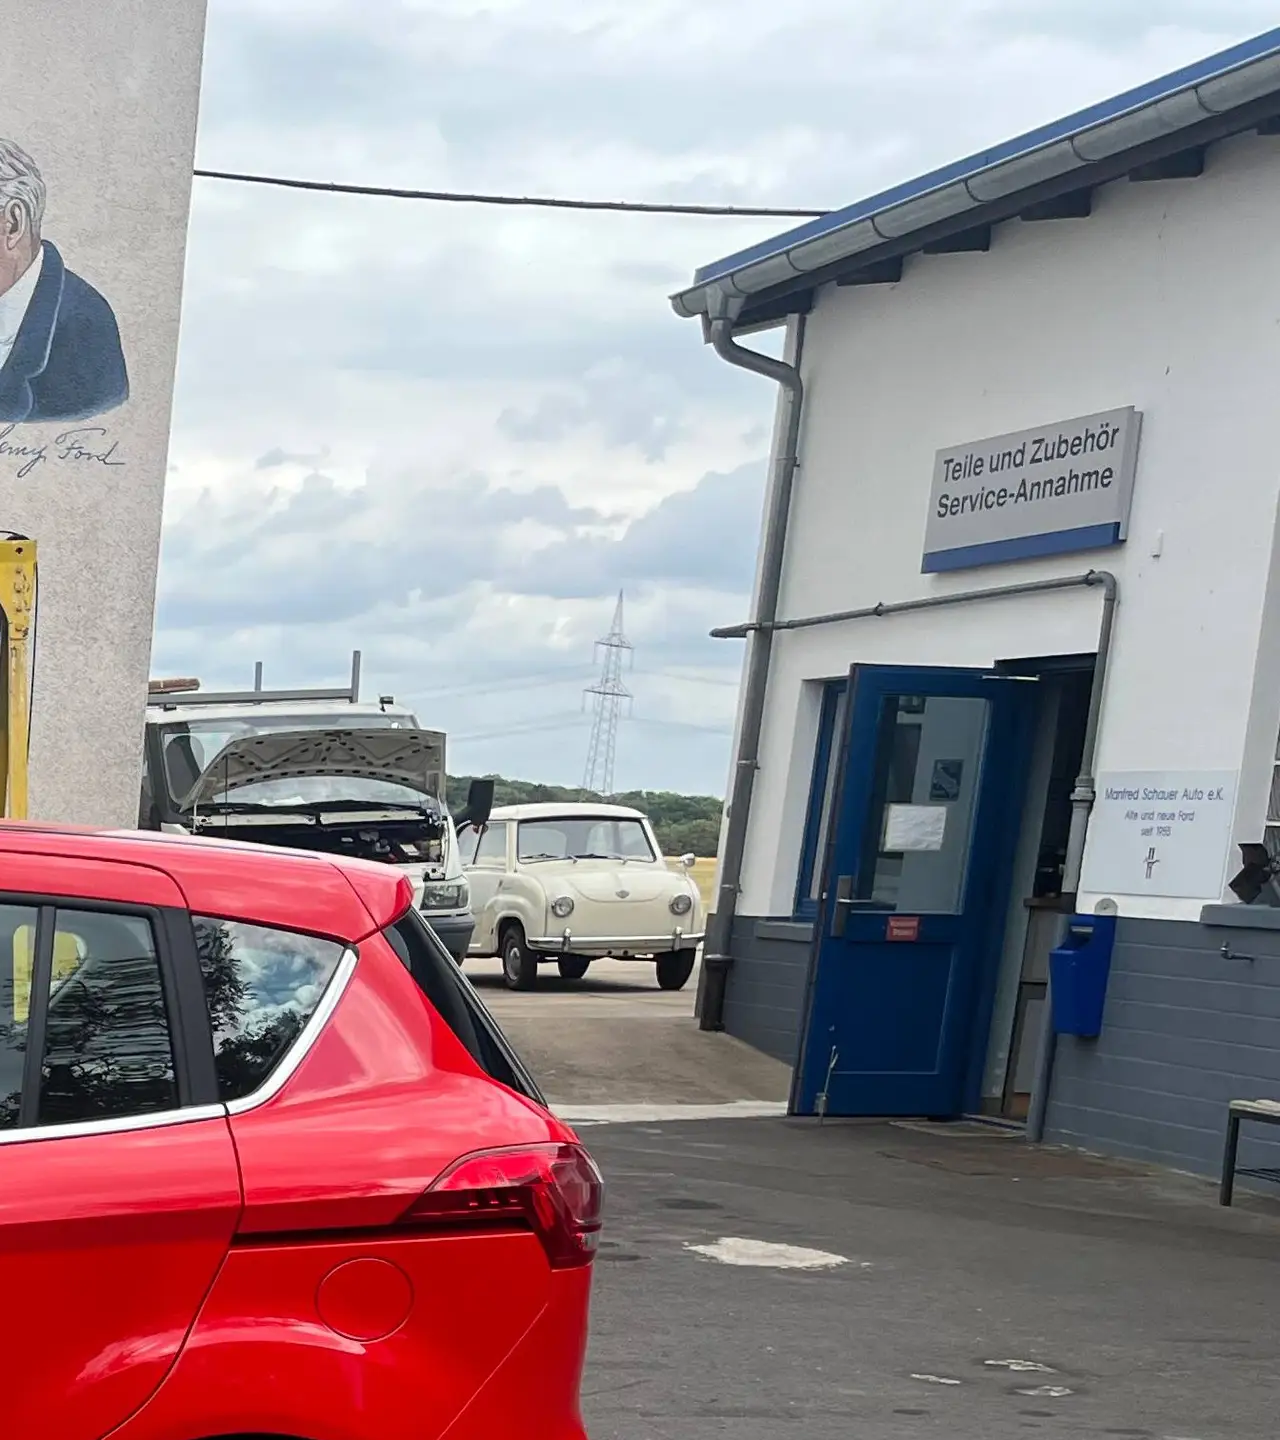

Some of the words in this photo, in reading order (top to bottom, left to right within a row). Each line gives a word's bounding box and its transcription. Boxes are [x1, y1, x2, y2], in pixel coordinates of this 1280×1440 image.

[55, 427, 126, 465] Ford
[943, 453, 984, 482] Teile
[989, 442, 1025, 472] und
[1030, 422, 1119, 464] Zubehör
[937, 467, 1113, 518] Service-Annahme
[1105, 788, 1139, 800] Manfred
[1142, 788, 1178, 800] Schauer
[1182, 788, 1203, 800] Auto
[1141, 811, 1154, 821] und
[1178, 811, 1195, 821] Ford
